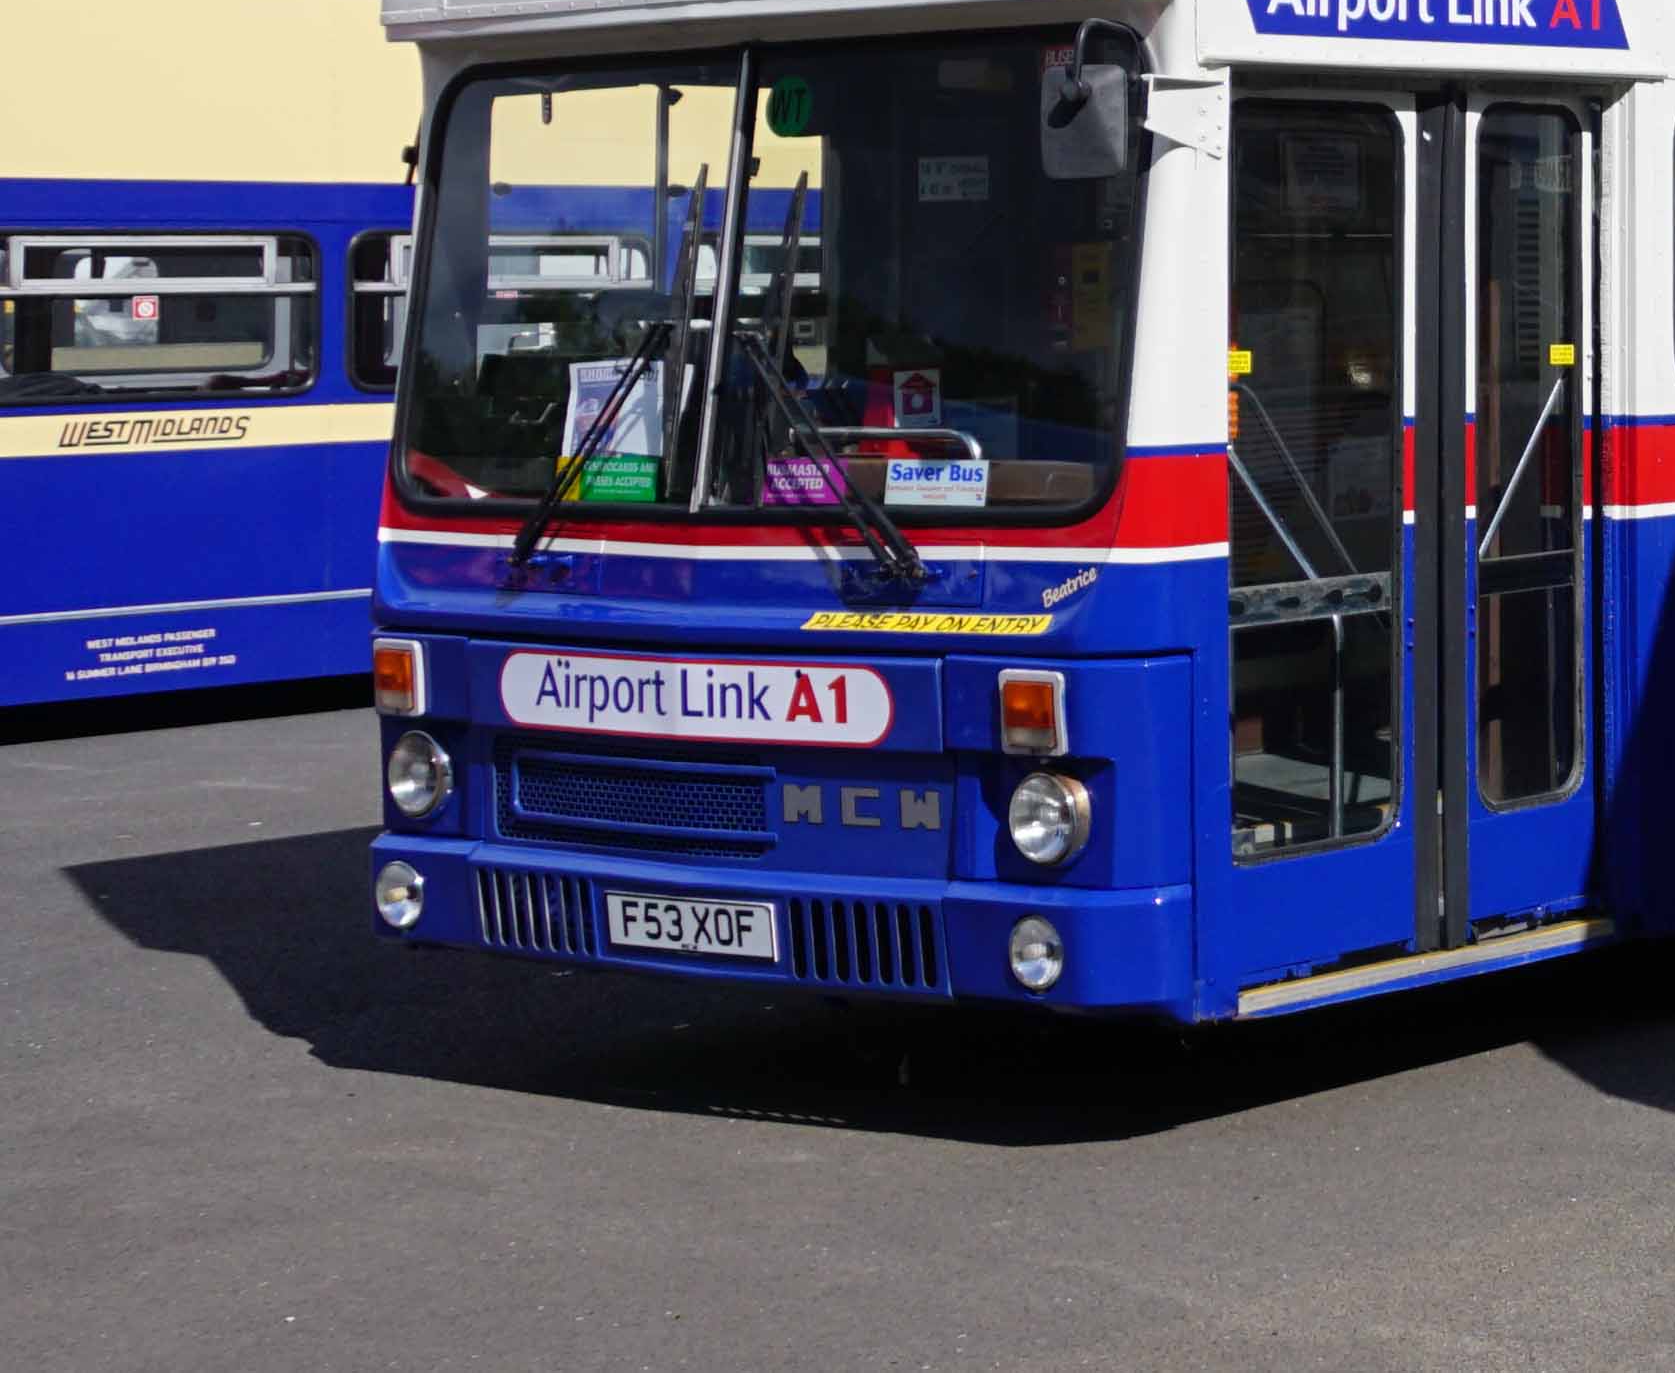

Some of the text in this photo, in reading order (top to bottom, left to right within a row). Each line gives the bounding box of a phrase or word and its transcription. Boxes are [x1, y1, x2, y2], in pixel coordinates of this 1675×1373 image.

[890, 463, 984, 483] Saver Bus
[1041, 567, 1097, 608] Beatrice
[812, 613, 1042, 634] PLEASE PAY ON ENTRY
[535, 658, 849, 725] Airport Link A1
[783, 783, 940, 830] MCW
[621, 900, 755, 948] F53 XOF
